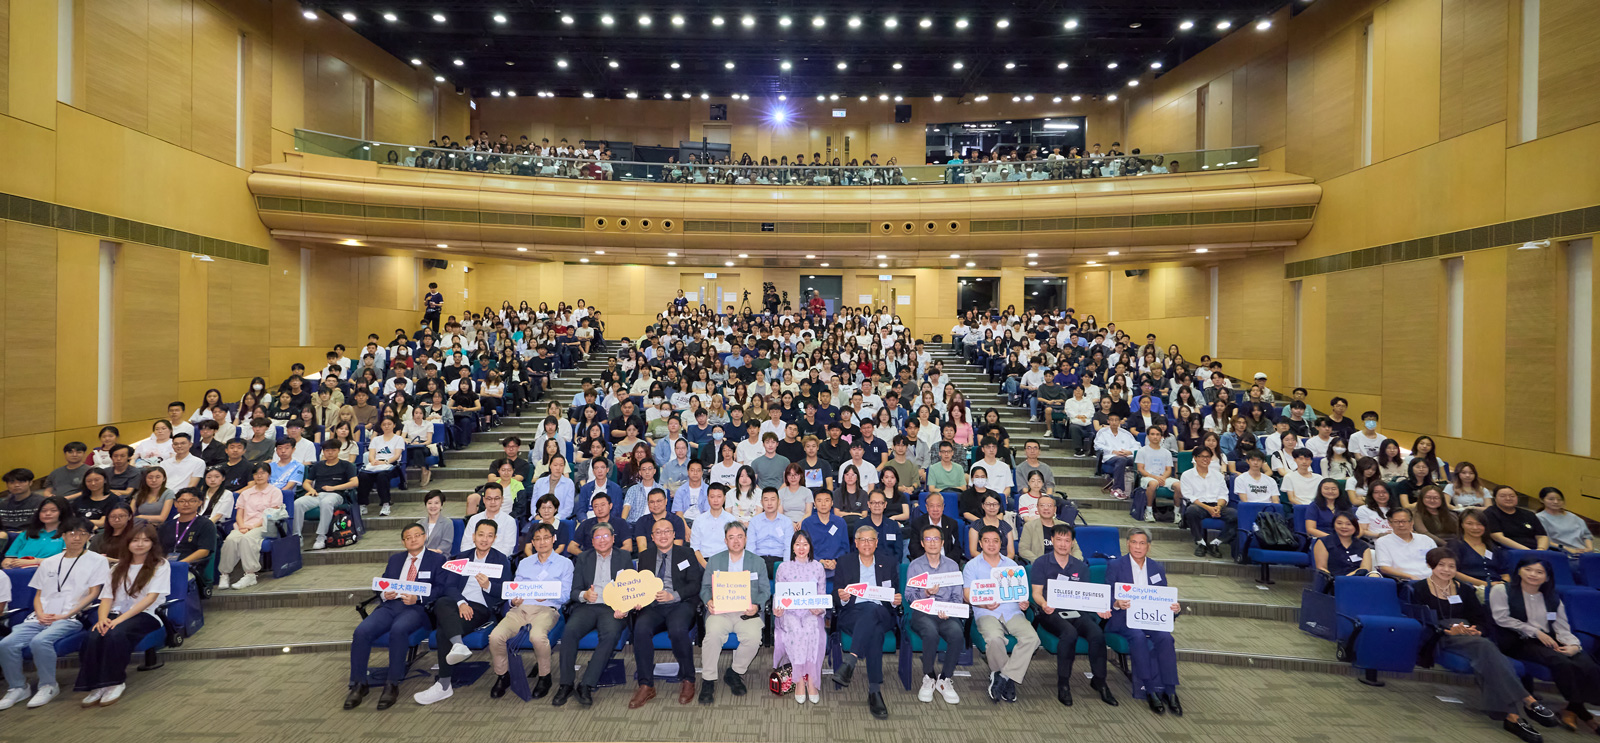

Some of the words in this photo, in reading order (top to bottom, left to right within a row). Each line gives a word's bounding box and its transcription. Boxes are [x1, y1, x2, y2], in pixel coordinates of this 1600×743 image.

[446, 563, 465, 572] CityU
[617, 578, 642, 587] Ready
[622, 592, 646, 601] Shine
[999, 585, 1027, 601] UP
[1134, 608, 1166, 622] cbslc
